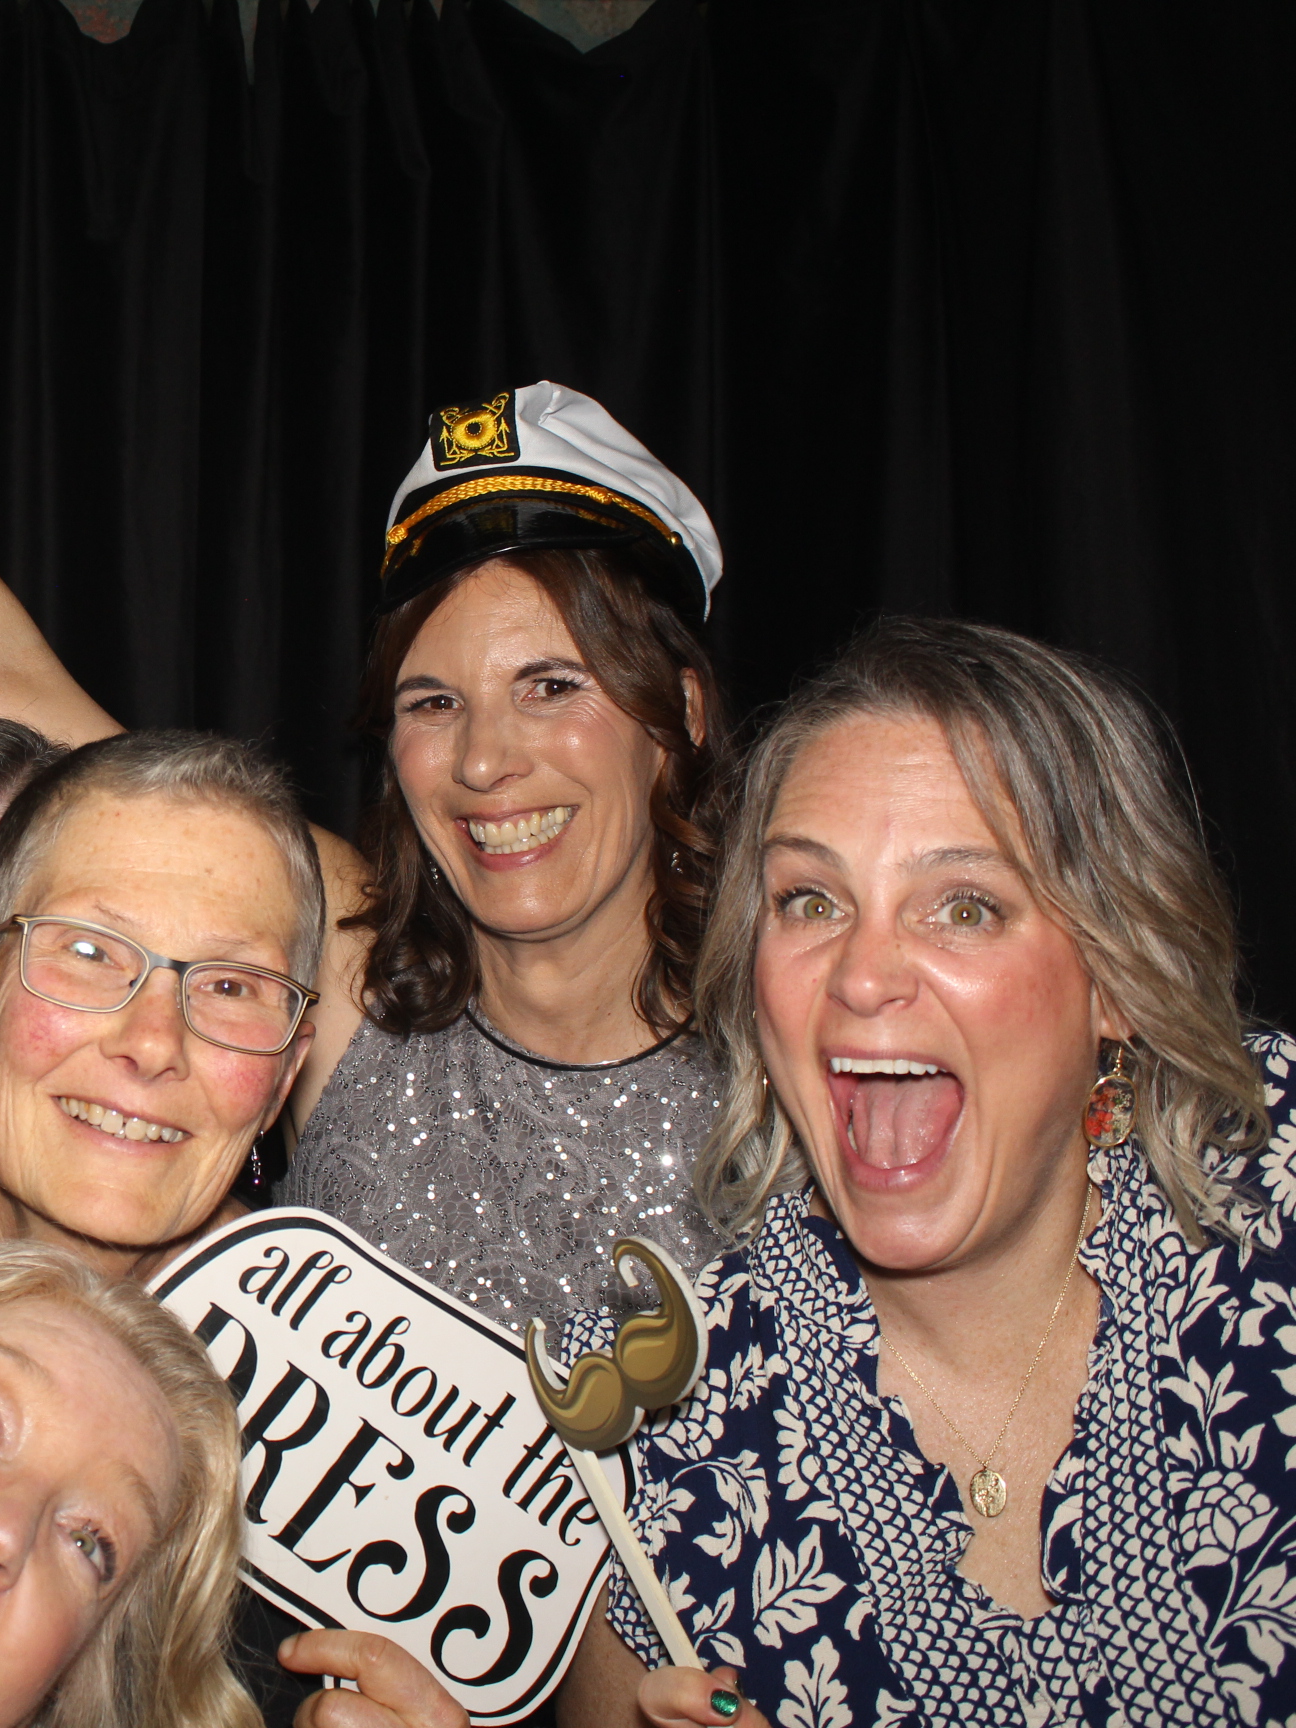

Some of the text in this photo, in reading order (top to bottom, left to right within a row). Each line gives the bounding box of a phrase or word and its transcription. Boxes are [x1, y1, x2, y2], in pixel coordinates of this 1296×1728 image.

[193, 1301, 560, 1687] DRESS
[238, 1245, 601, 1547] all about the
